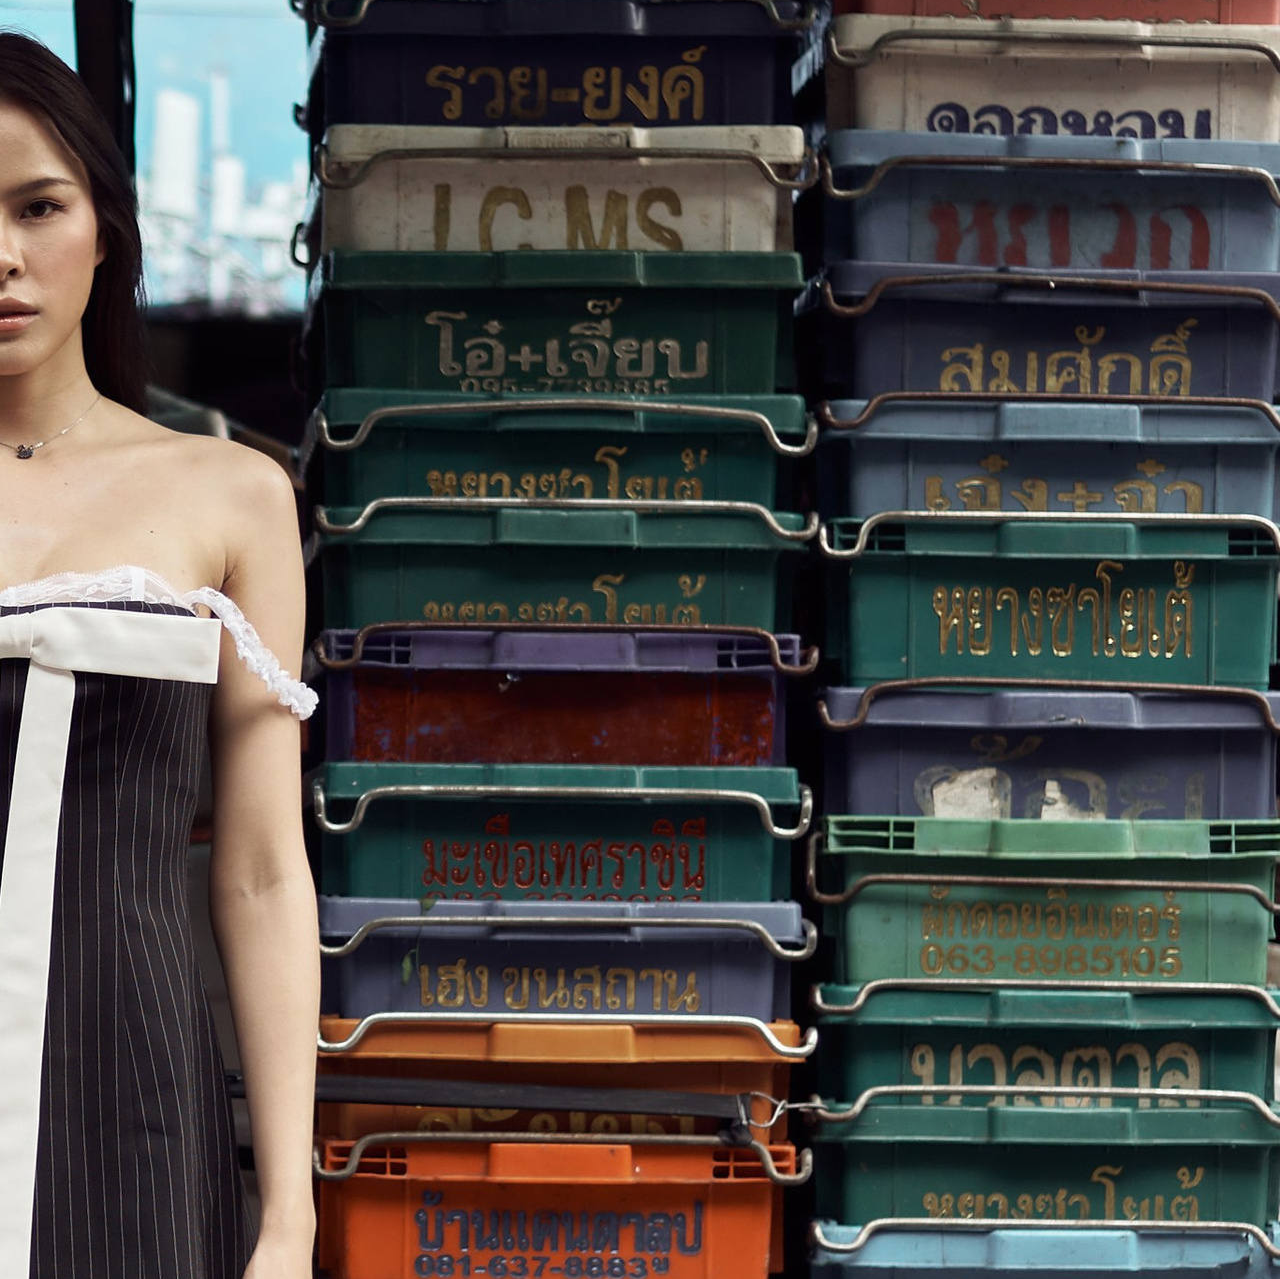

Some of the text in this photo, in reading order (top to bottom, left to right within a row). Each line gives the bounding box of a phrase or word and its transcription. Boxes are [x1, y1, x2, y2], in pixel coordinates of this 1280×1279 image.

[426, 46, 707, 121] รวย-ยงค์
[939, 318, 1198, 394] สมศักดิ์
[422, 814, 706, 890] มะเขือเทศราชินี
[920, 944, 1183, 977] 063-8985105
